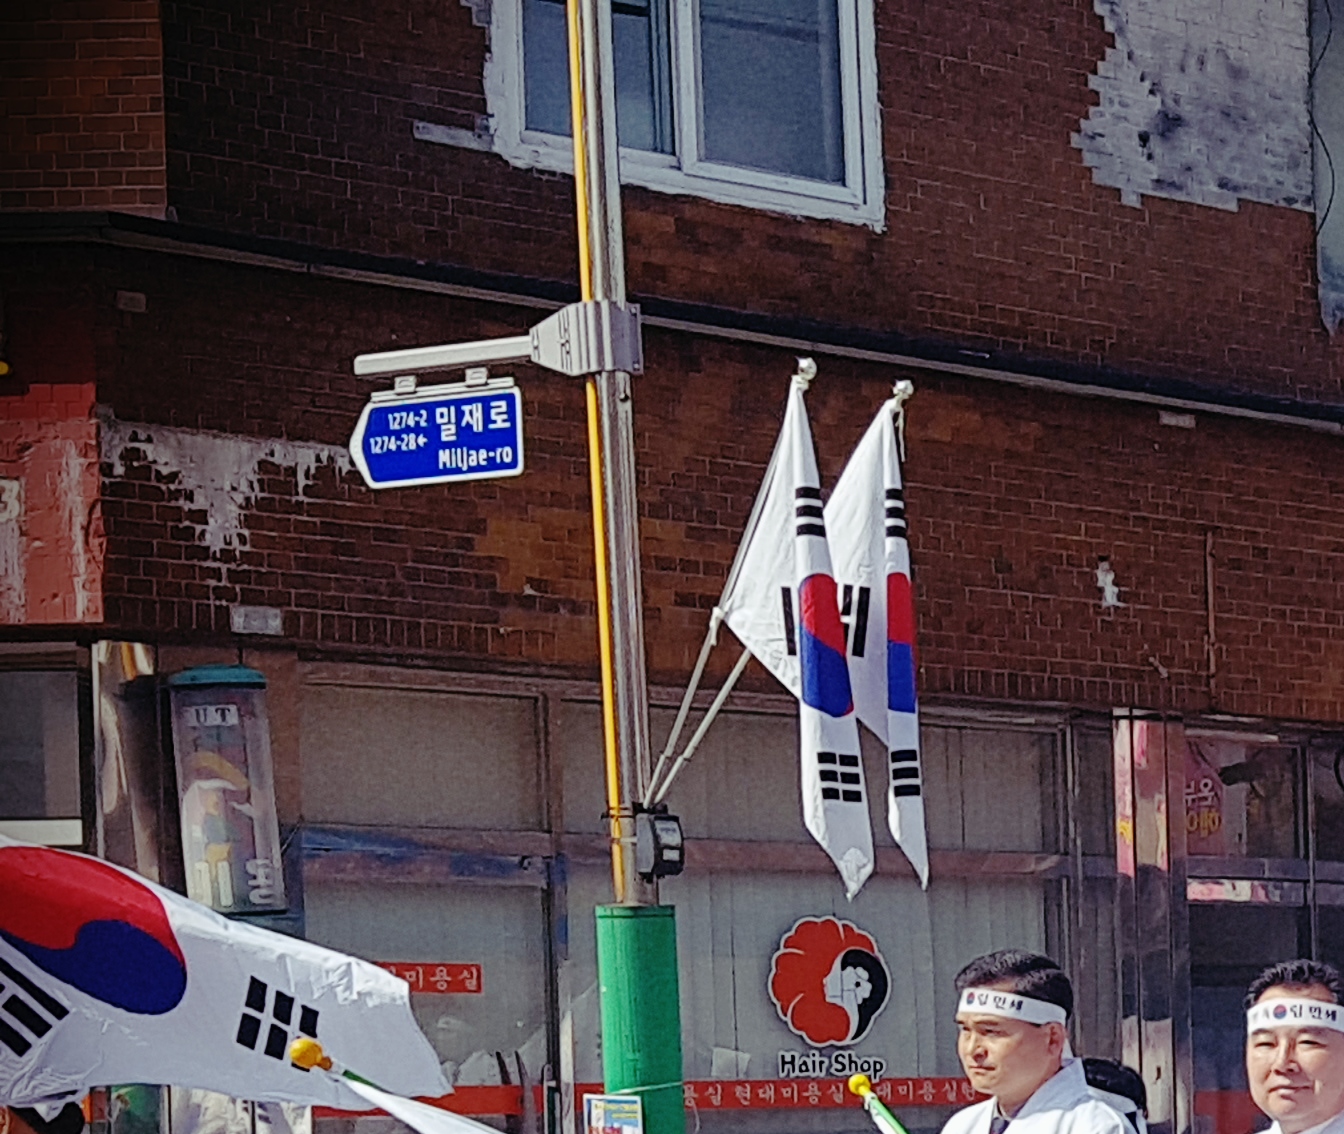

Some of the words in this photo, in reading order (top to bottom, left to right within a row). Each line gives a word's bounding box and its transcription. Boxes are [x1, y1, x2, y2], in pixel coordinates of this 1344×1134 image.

[387, 409, 428, 430] 1274-2
[435, 400, 511, 441] 밀재로
[369, 433, 417, 454] 1274-28
[438, 446, 513, 471] Miljae-ro
[389, 965, 478, 991] 미용실
[779, 1052, 826, 1075] Hair
[834, 1052, 885, 1080] Shop
